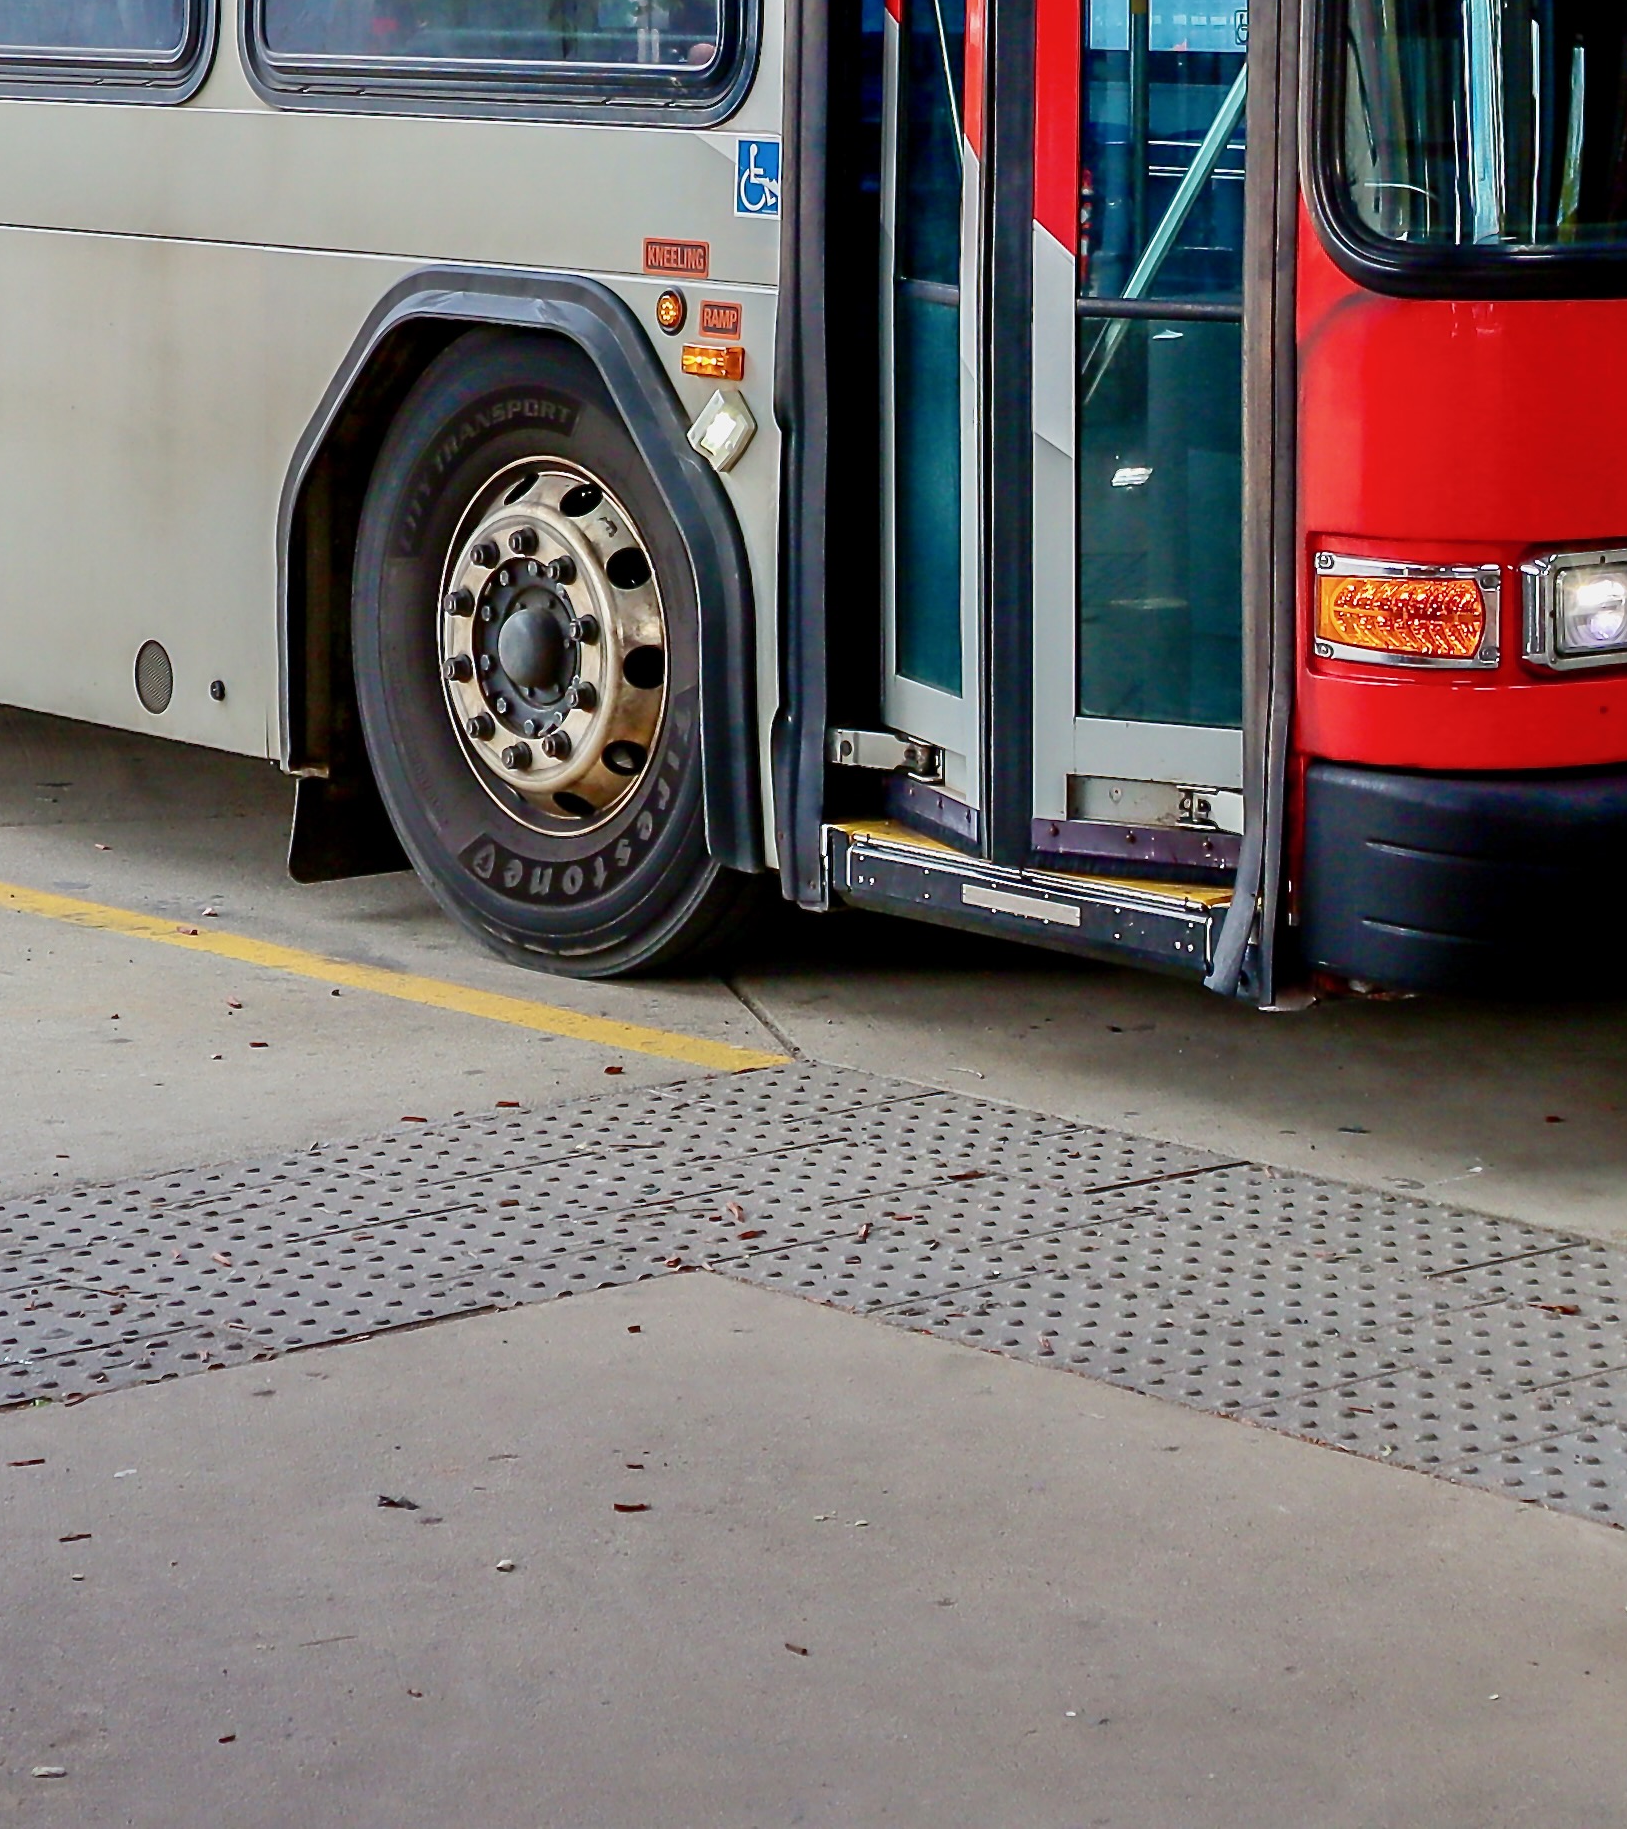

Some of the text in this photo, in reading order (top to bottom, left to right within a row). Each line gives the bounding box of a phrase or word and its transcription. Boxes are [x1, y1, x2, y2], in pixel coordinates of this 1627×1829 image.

[647, 244, 705, 270] KNEELING
[703, 307, 737, 329] RAMP
[434, 398, 572, 473] TRANSPORT
